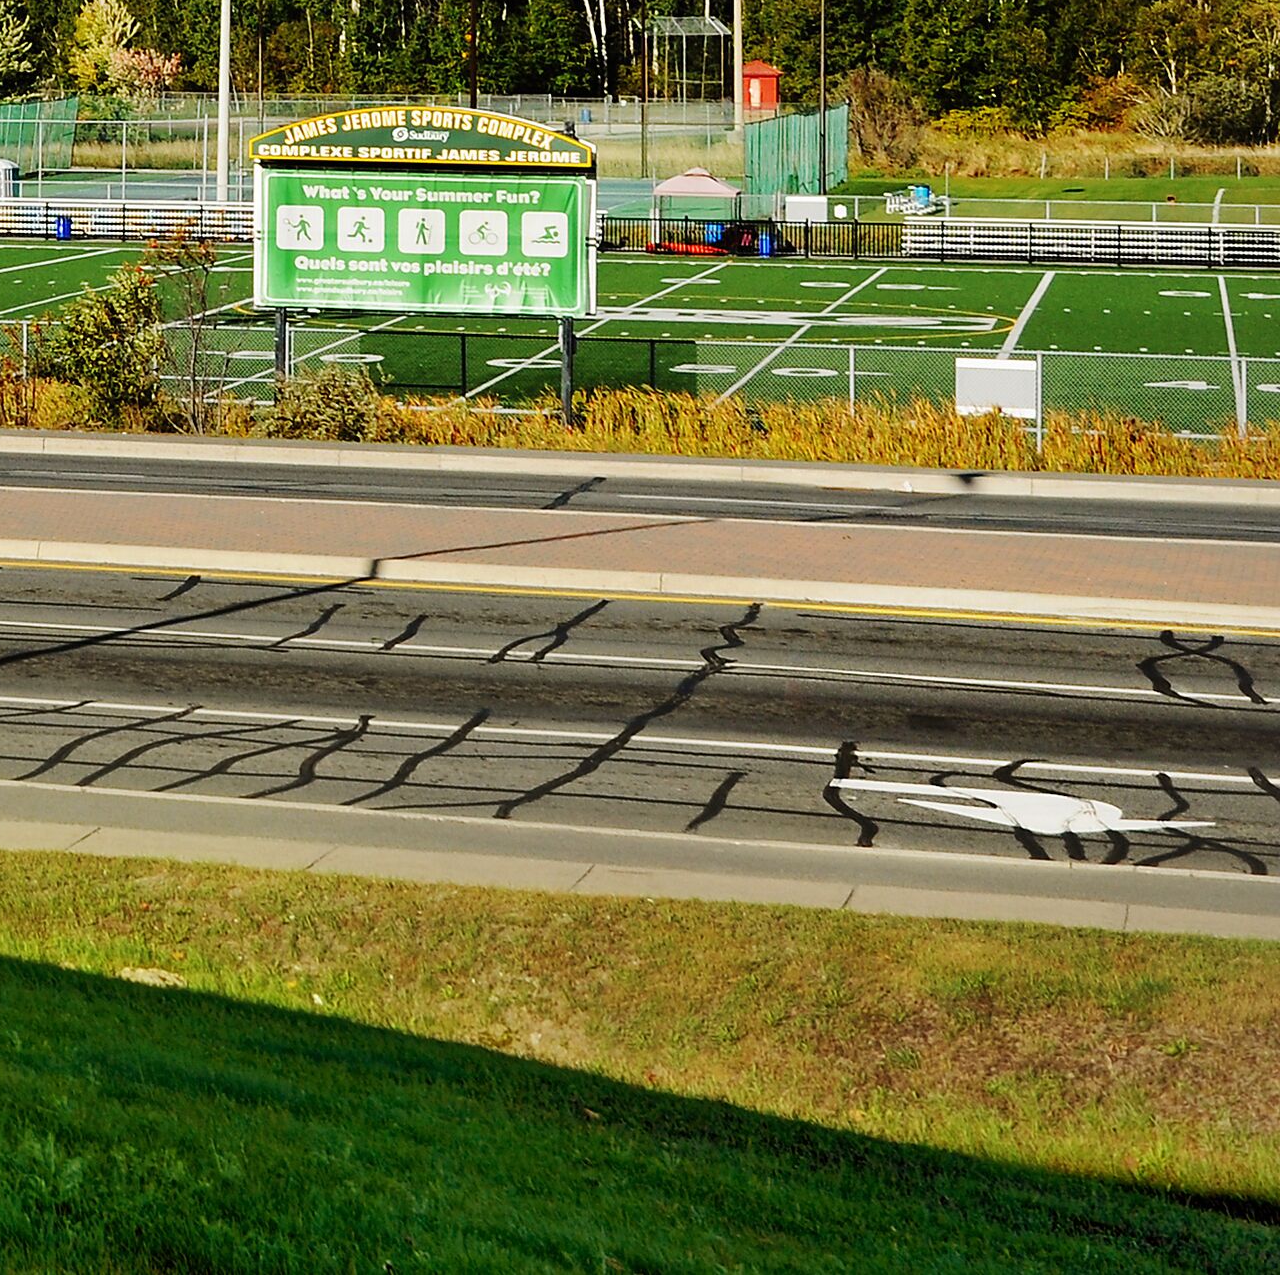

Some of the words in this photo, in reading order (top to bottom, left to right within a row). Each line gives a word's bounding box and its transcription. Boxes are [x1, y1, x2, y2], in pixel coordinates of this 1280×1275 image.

[284, 117, 338, 144] JAMES
[341, 111, 407, 131] JEROME
[410, 109, 473, 131] SPORTS
[476, 116, 554, 150] COMPLEX
[408, 129, 450, 148] Sudbury
[257, 144, 353, 158] COMPLEXE
[357, 147, 432, 159] SPORTIF
[436, 149, 500, 161] JAMES
[504, 150, 581, 163] JEROME
[369, 186, 413, 202] Your
[415, 187, 493, 203] Summer
[495, 189, 541, 204] Fun?
[294, 255, 346, 271] Quels
[348, 258, 388, 272] sont
[390, 261, 421, 273] vos
[423, 260, 494, 276] plaisirs
[496, 261, 551, 276] d'été?
